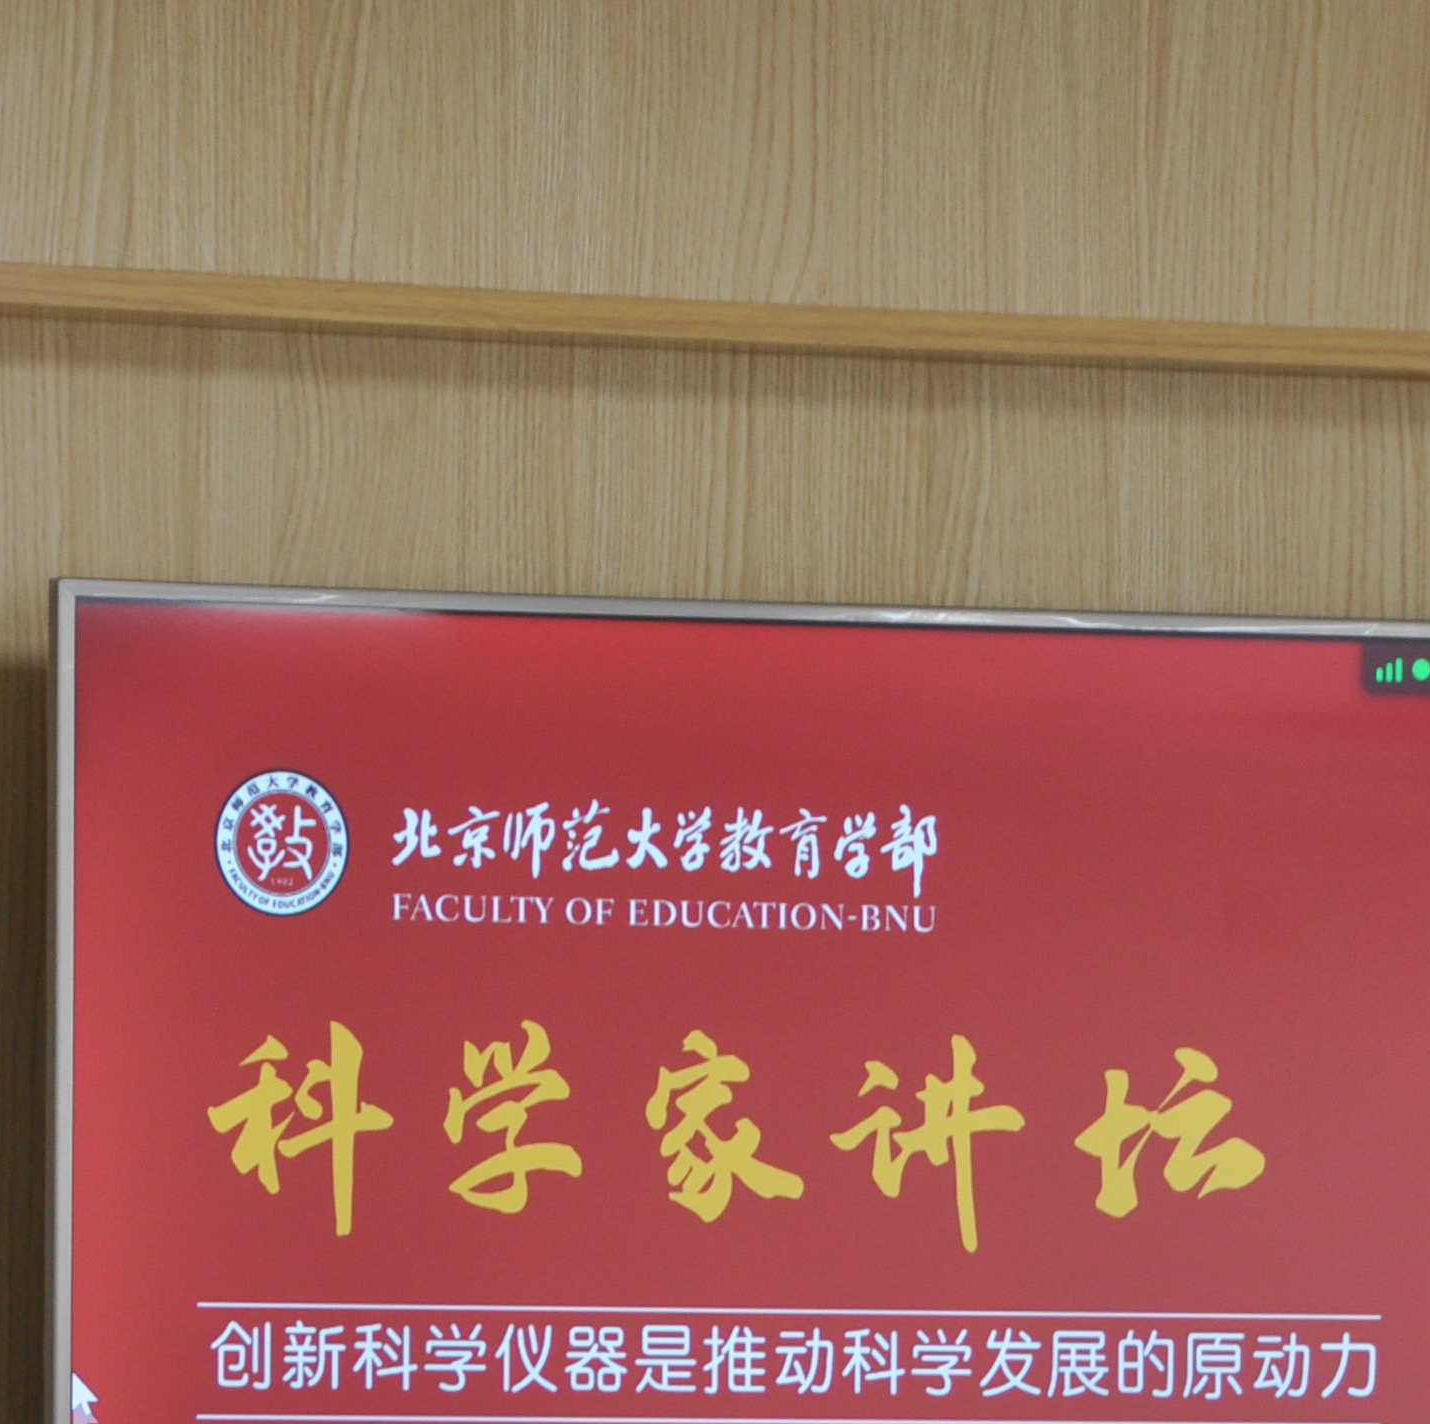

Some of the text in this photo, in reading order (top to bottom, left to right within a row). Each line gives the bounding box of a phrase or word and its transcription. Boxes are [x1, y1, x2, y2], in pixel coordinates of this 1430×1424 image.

[391, 799, 938, 897] 北京师范大学教育学部
[392, 893, 937, 934] FACULTY OF EDUCATION-BNU
[207, 1019, 1267, 1254] 科学家讲坛
[210, 1319, 1381, 1400] 创新科学仪器是推动科学发展的原动力
